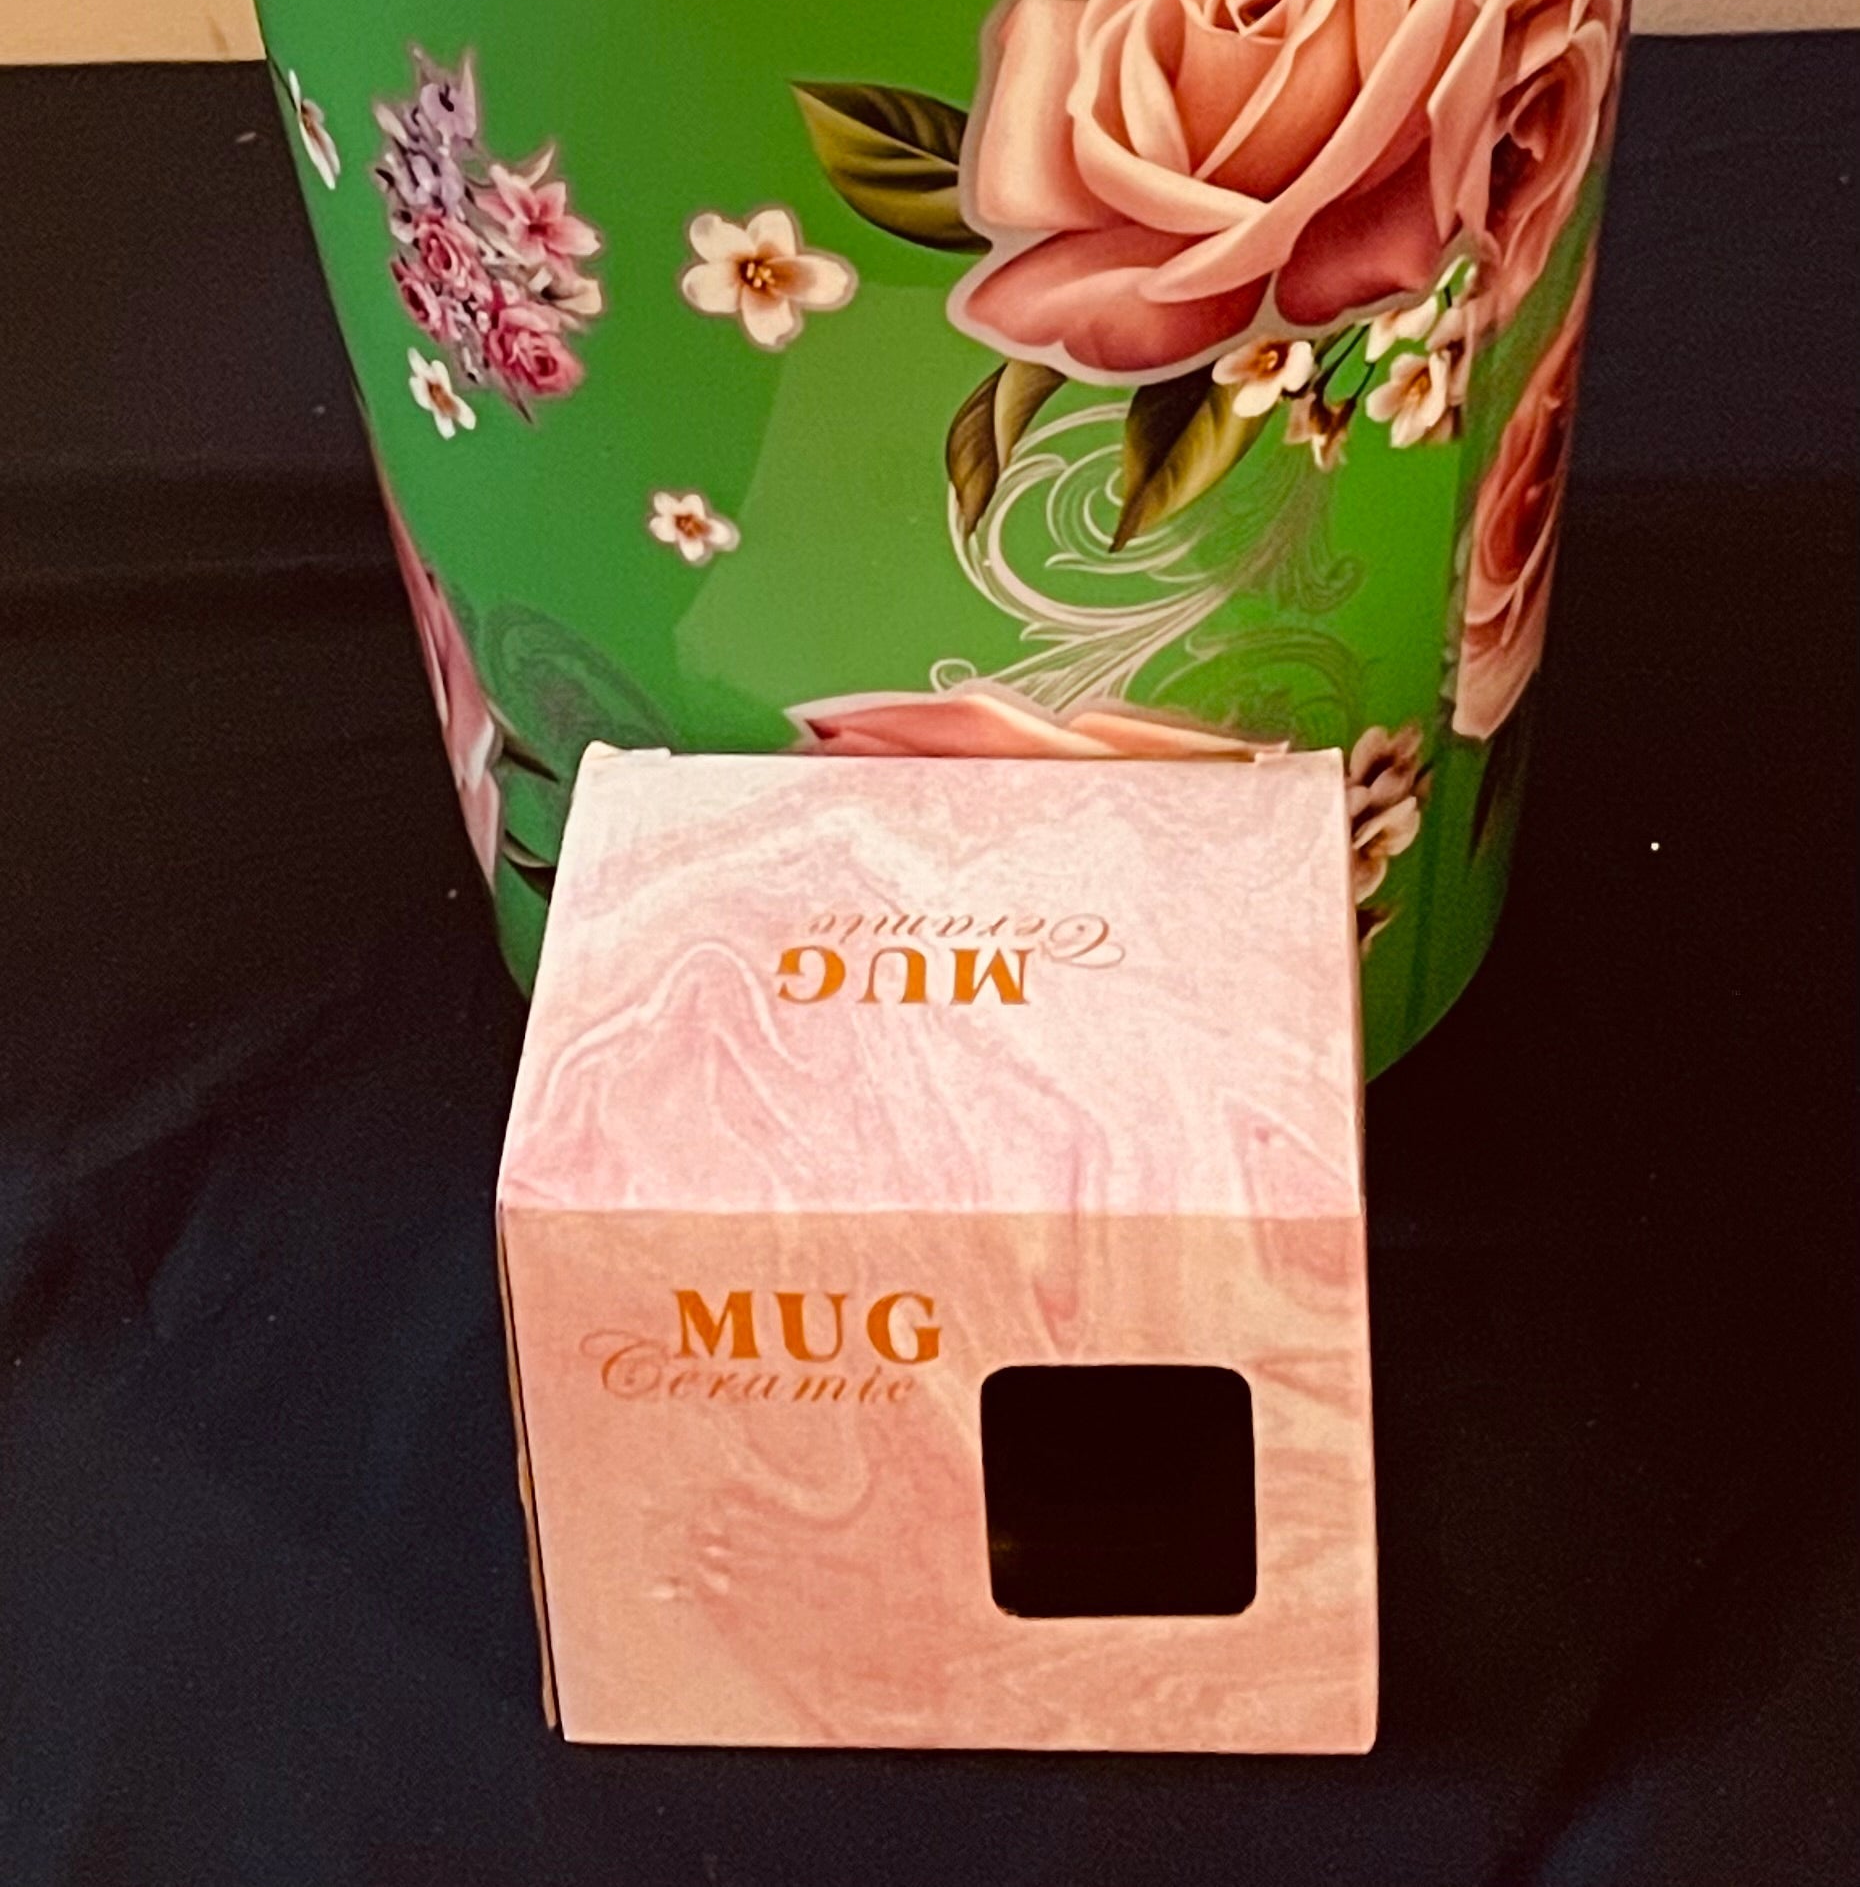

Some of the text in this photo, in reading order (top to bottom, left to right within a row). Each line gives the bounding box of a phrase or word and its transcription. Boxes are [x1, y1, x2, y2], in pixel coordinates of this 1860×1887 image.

[809, 912, 1126, 969] Ceramic
[776, 945, 1036, 1006] MUG
[671, 1289, 942, 1365] MUG
[579, 1330, 915, 1404] Ceramic
